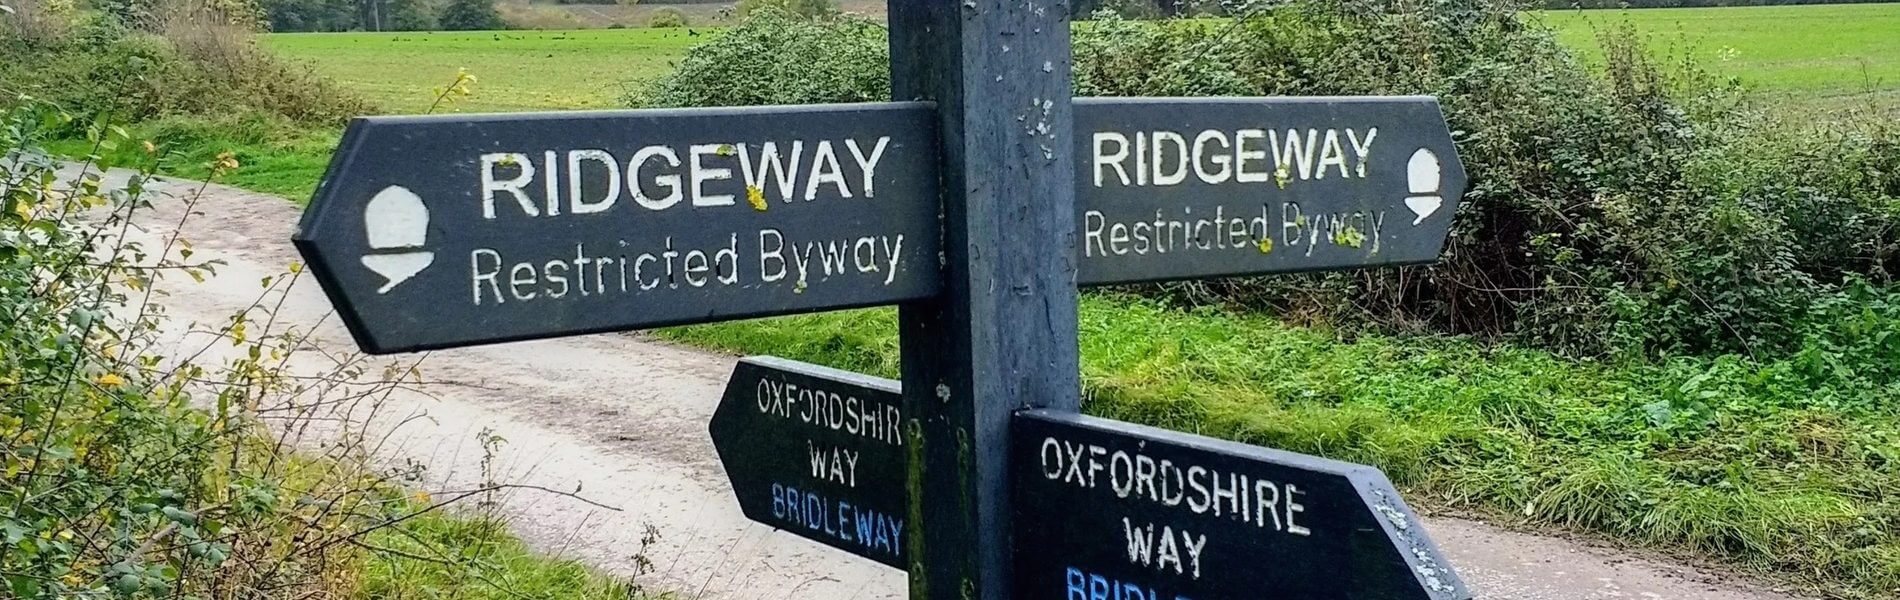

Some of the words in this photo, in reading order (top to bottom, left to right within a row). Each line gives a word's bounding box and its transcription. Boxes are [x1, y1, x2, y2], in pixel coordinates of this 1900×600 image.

[480, 136, 890, 219] RIDGEWAY
[1093, 127, 1378, 187] RIDGEWAY
[1085, 203, 1269, 258] Restricted
[1282, 201, 1385, 257] Byway
[470, 232, 738, 305] Restricted
[759, 228, 905, 294] Byway
[757, 378, 902, 445] OXFORDSHIR
[808, 439, 859, 488] WAY
[1041, 436, 1311, 536] OXFORDSHIRE
[771, 482, 903, 555] BRIDLEWAY
[1123, 516, 1207, 580] WAY
